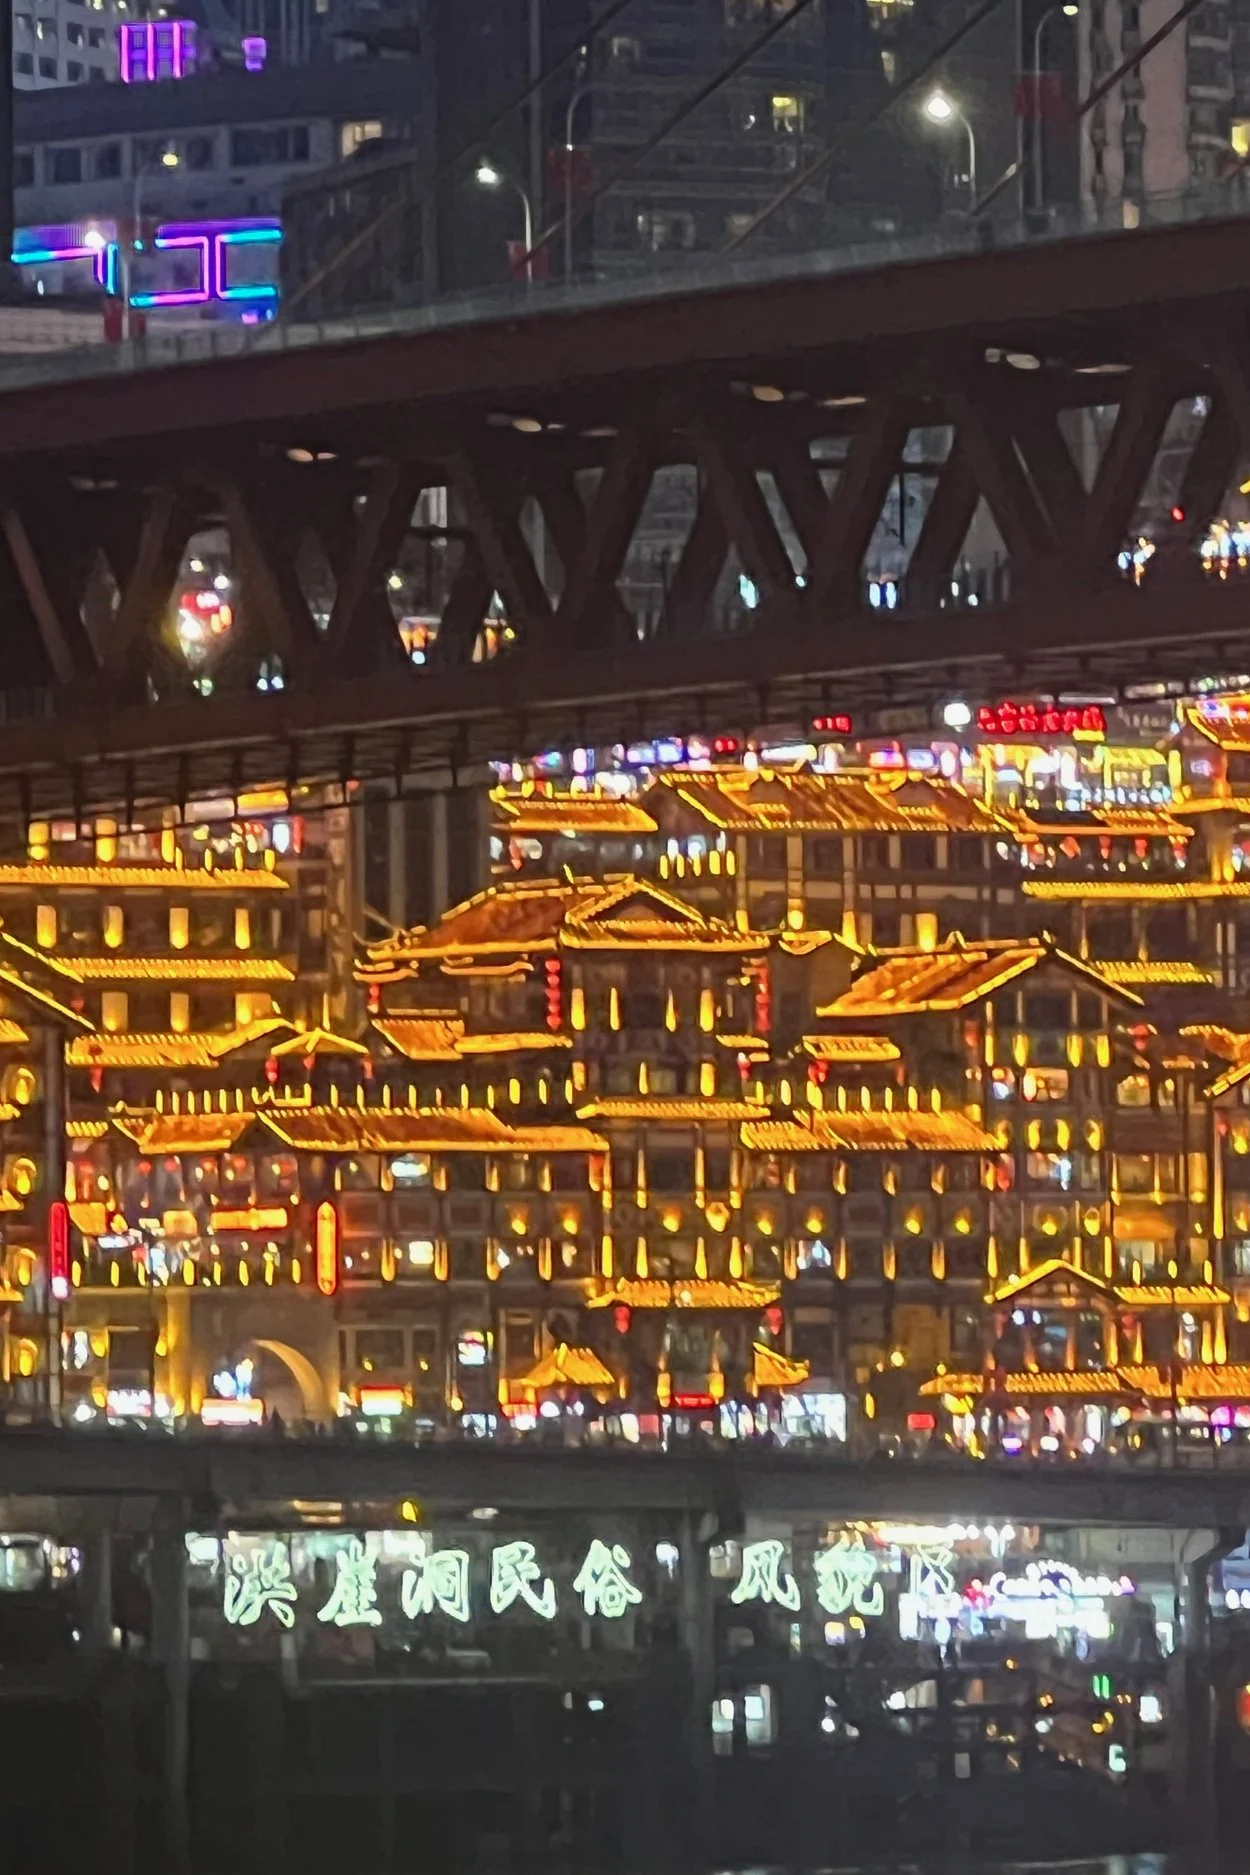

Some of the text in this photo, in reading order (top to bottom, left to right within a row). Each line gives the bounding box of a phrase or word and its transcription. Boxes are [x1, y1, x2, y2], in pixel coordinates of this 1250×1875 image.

[222, 1538, 644, 1628] 洪崖洞民俗
